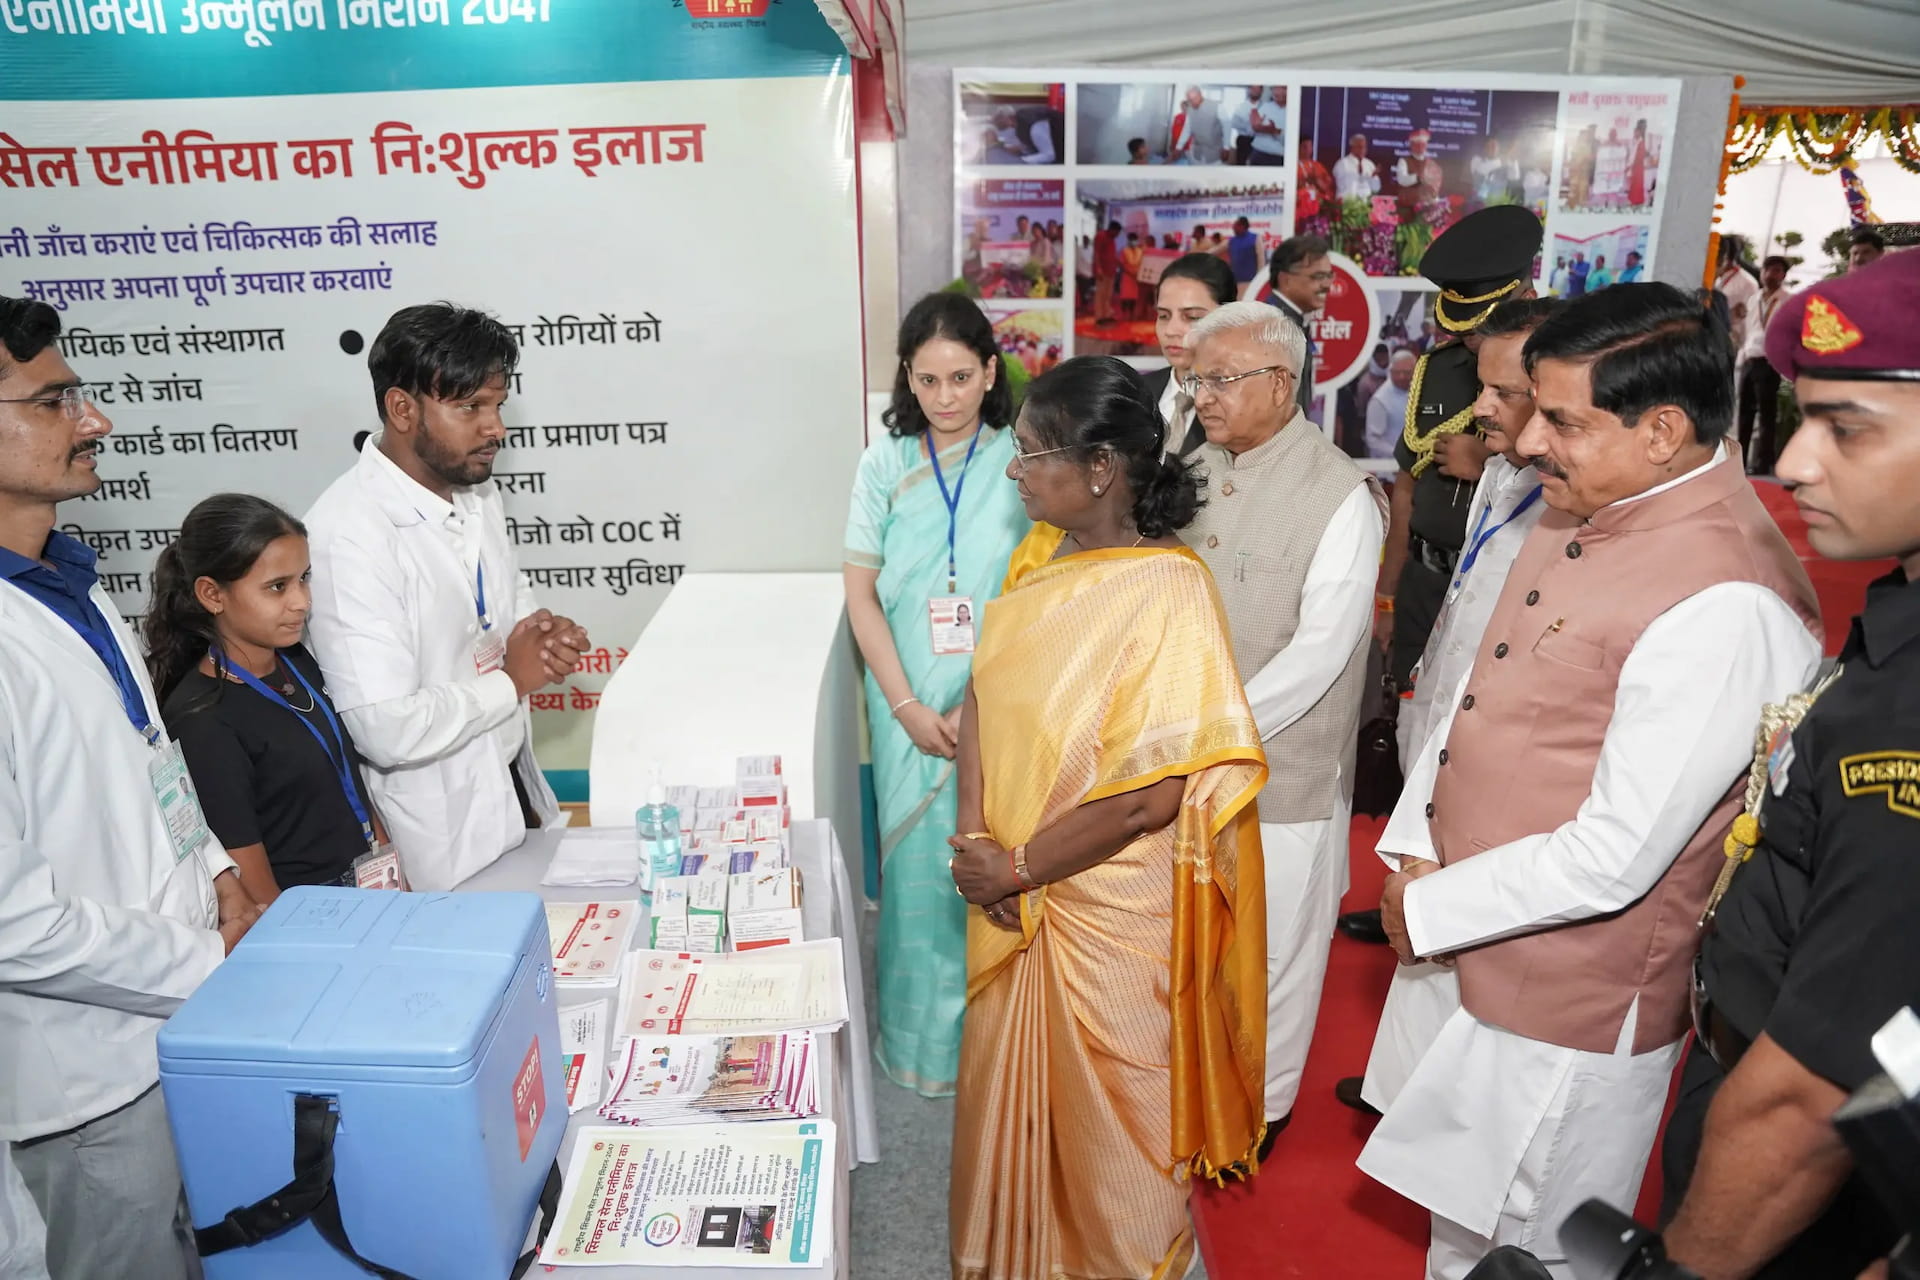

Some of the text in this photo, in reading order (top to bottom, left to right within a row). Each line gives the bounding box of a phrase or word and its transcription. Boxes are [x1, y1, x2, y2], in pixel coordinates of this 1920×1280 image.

[0, 121, 706, 189] सेल एनीमिया का नि:शुल्क इलाज
[0, 216, 438, 257] नी जाँच कराएं एवं चिकित्सक की सलाह
[22, 262, 393, 311] अनुसार अपना पूर्ण उपचार करवाएं
[130, 325, 171, 355] एवं
[176, 325, 285, 354] संस्थागत
[531, 313, 617, 346] रोगियों
[622, 312, 662, 343] को
[1320, 315, 1353, 340] सेल
[119, 373, 144, 402] से
[148, 372, 203, 401] जांच
[111, 425, 165, 455] कार्ड
[170, 432, 205, 453] का
[211, 424, 298, 452] वितरण
[542, 423, 620, 447] प्रमाण
[625, 422, 668, 444] पत्र
[557, 515, 594, 544] को
[602, 520, 654, 542] COC
[659, 512, 681, 541] में
[1849, 760, 1920, 786] PRESID
[1897, 782, 1920, 806] IN
[516, 1047, 540, 1105] STOP!
[622, 1163, 639, 1190] इलाज
[584, 1144, 631, 1254] सिकल सेल एनीमिया का
